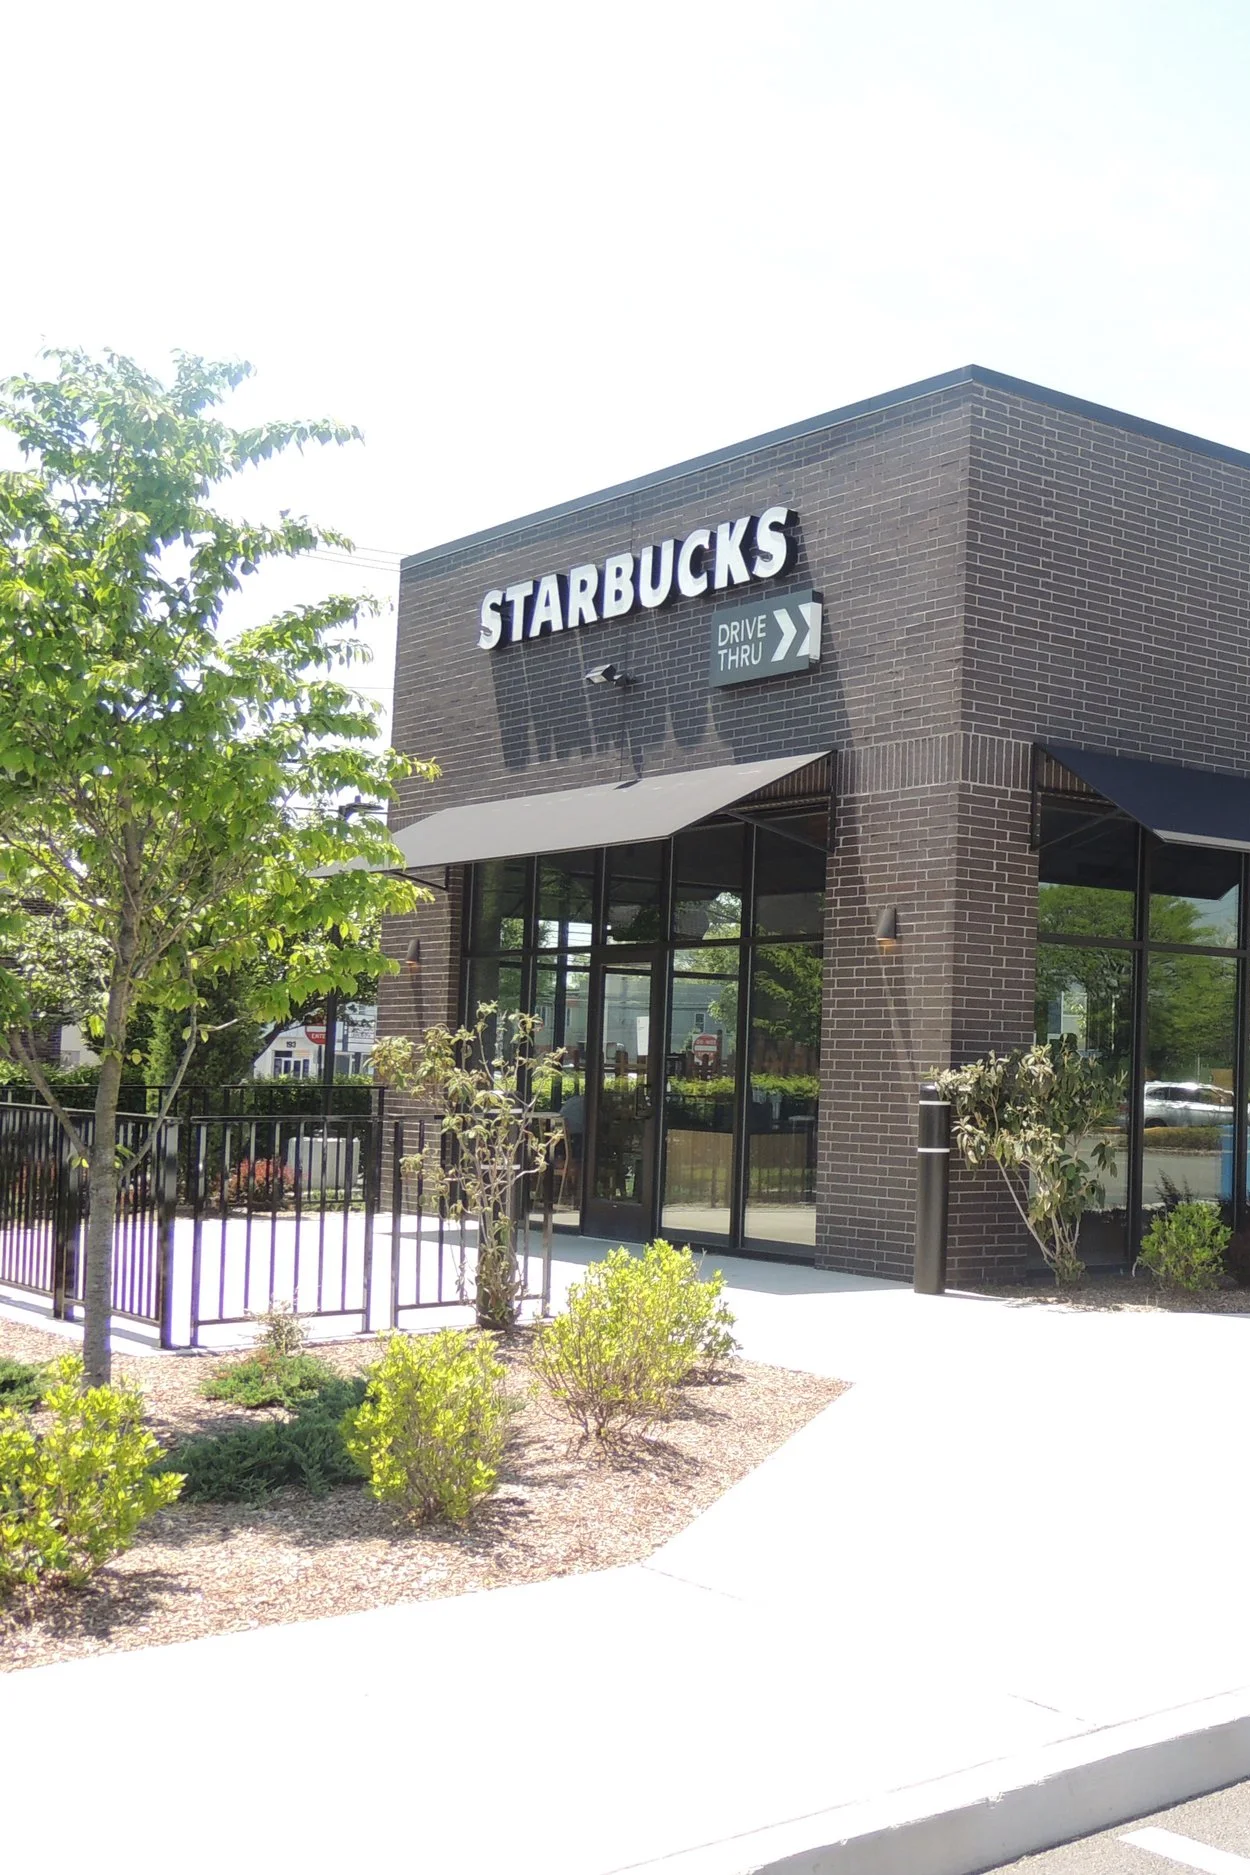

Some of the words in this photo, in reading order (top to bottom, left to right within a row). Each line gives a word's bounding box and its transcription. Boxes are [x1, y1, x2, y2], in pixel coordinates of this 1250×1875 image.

[476, 507, 789, 650] STARBUCKS
[717, 614, 767, 648] DRIVE
[717, 643, 763, 672] THRU
